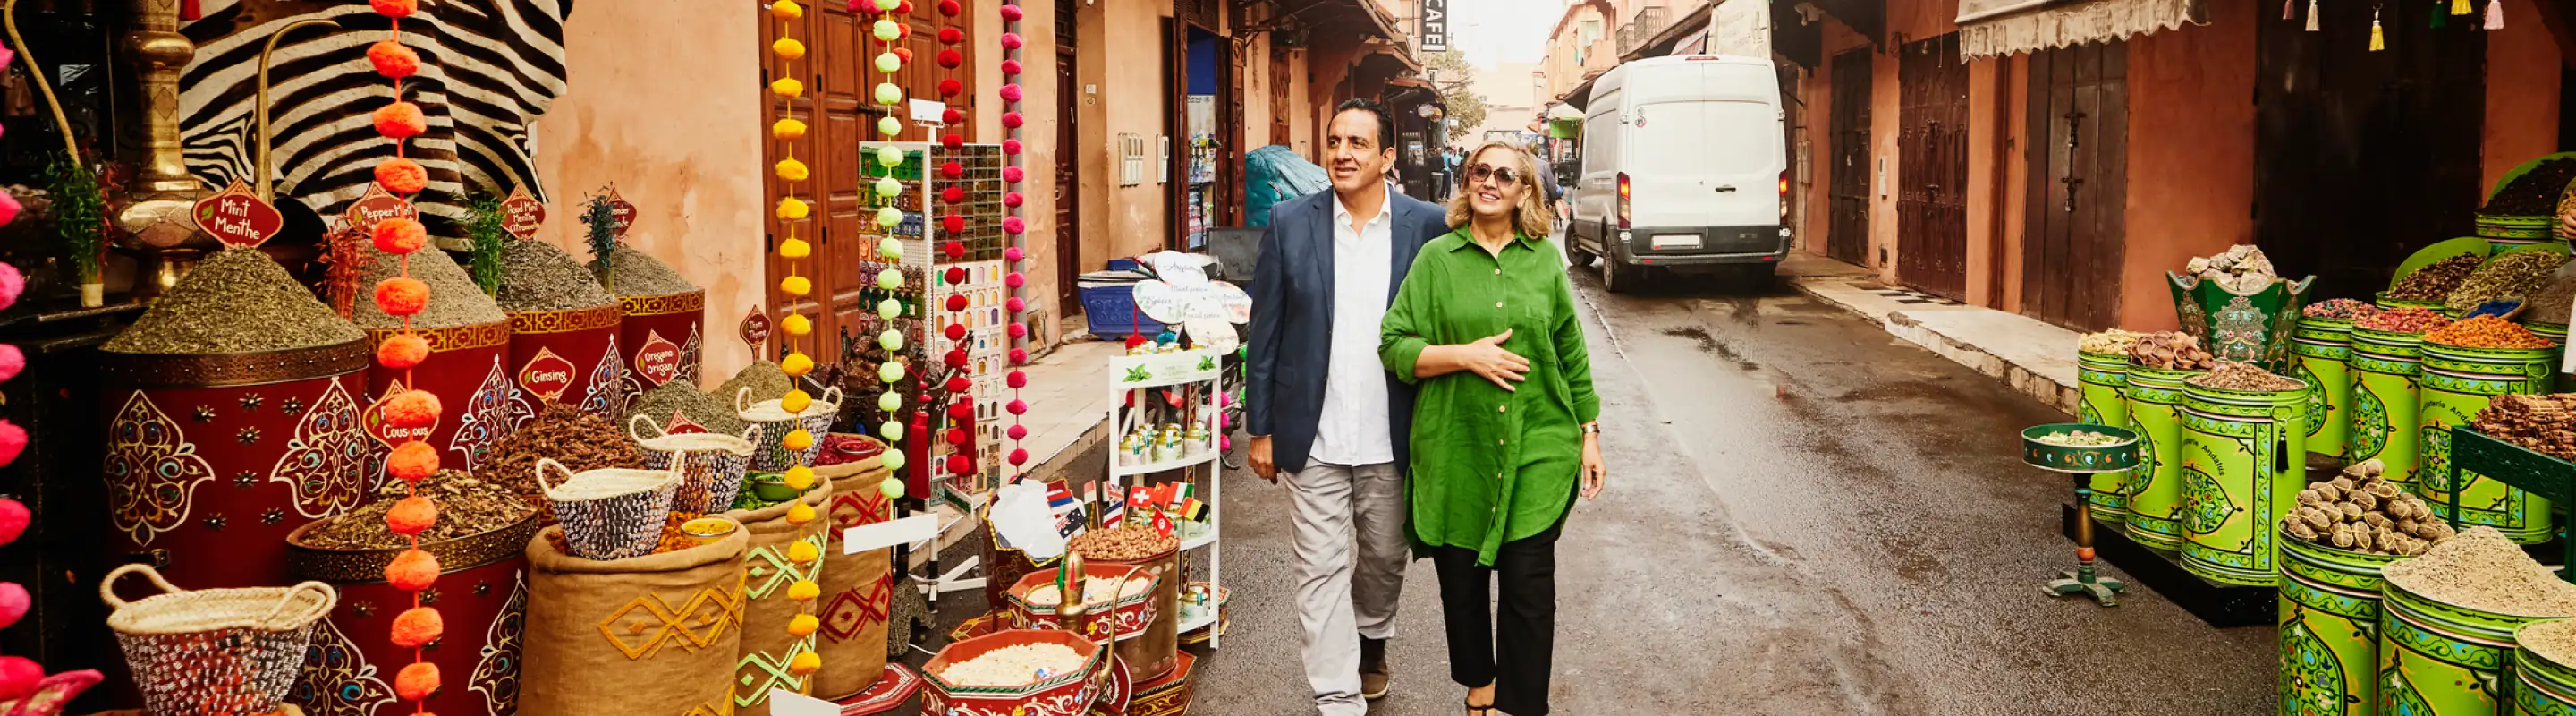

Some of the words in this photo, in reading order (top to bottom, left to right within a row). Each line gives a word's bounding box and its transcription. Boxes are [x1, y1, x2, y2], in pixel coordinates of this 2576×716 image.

[1426, 0, 1443, 44] CAFE
[221, 198, 250, 217] Mint
[215, 216, 260, 239] Menthe
[645, 350, 674, 363] Oregano
[531, 370, 567, 383] Ginsing
[647, 362, 673, 376] Origan
[382, 424, 428, 439] Cousous
[2201, 445, 2224, 476] Andalus
